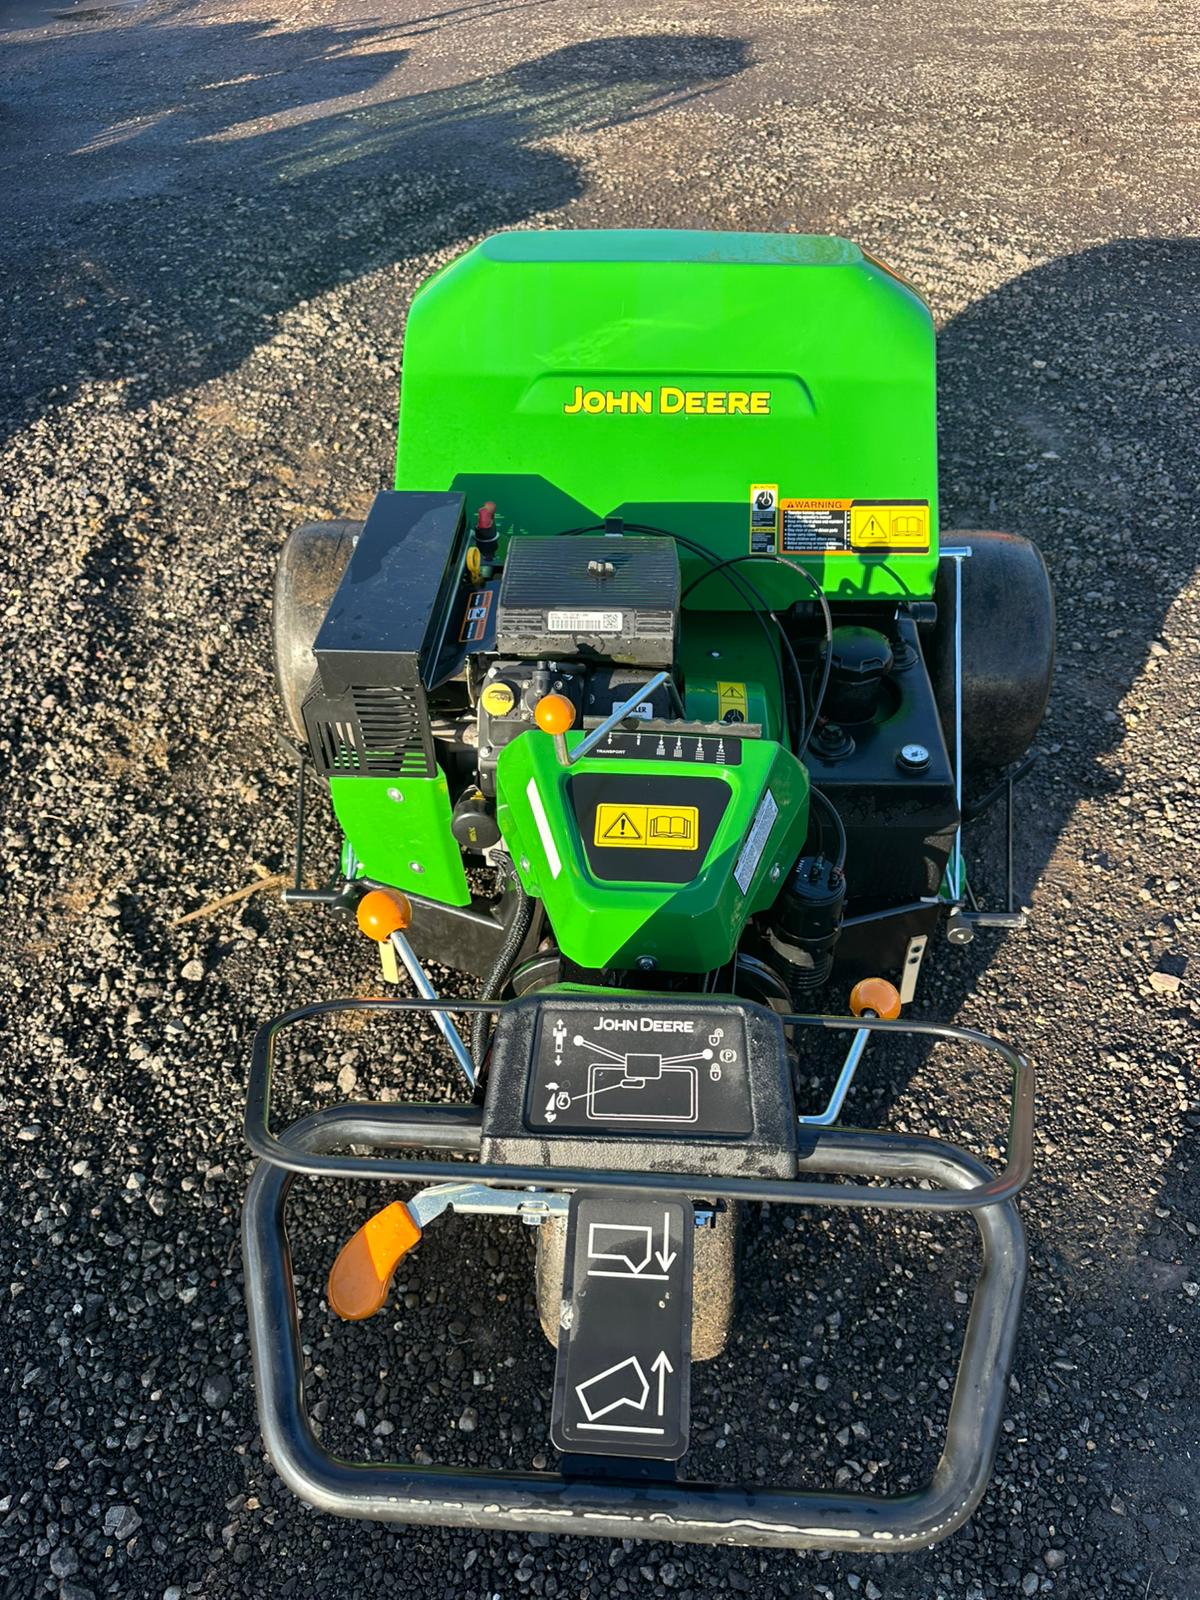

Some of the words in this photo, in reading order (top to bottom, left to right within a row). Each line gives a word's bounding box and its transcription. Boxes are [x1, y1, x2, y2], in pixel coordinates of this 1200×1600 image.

[564, 386, 653, 415] JOHN
[660, 386, 771, 415] DEERE
[795, 501, 842, 509] WARNING
[593, 1016, 638, 1032] JOHN
[640, 1017, 694, 1033] DEERE
